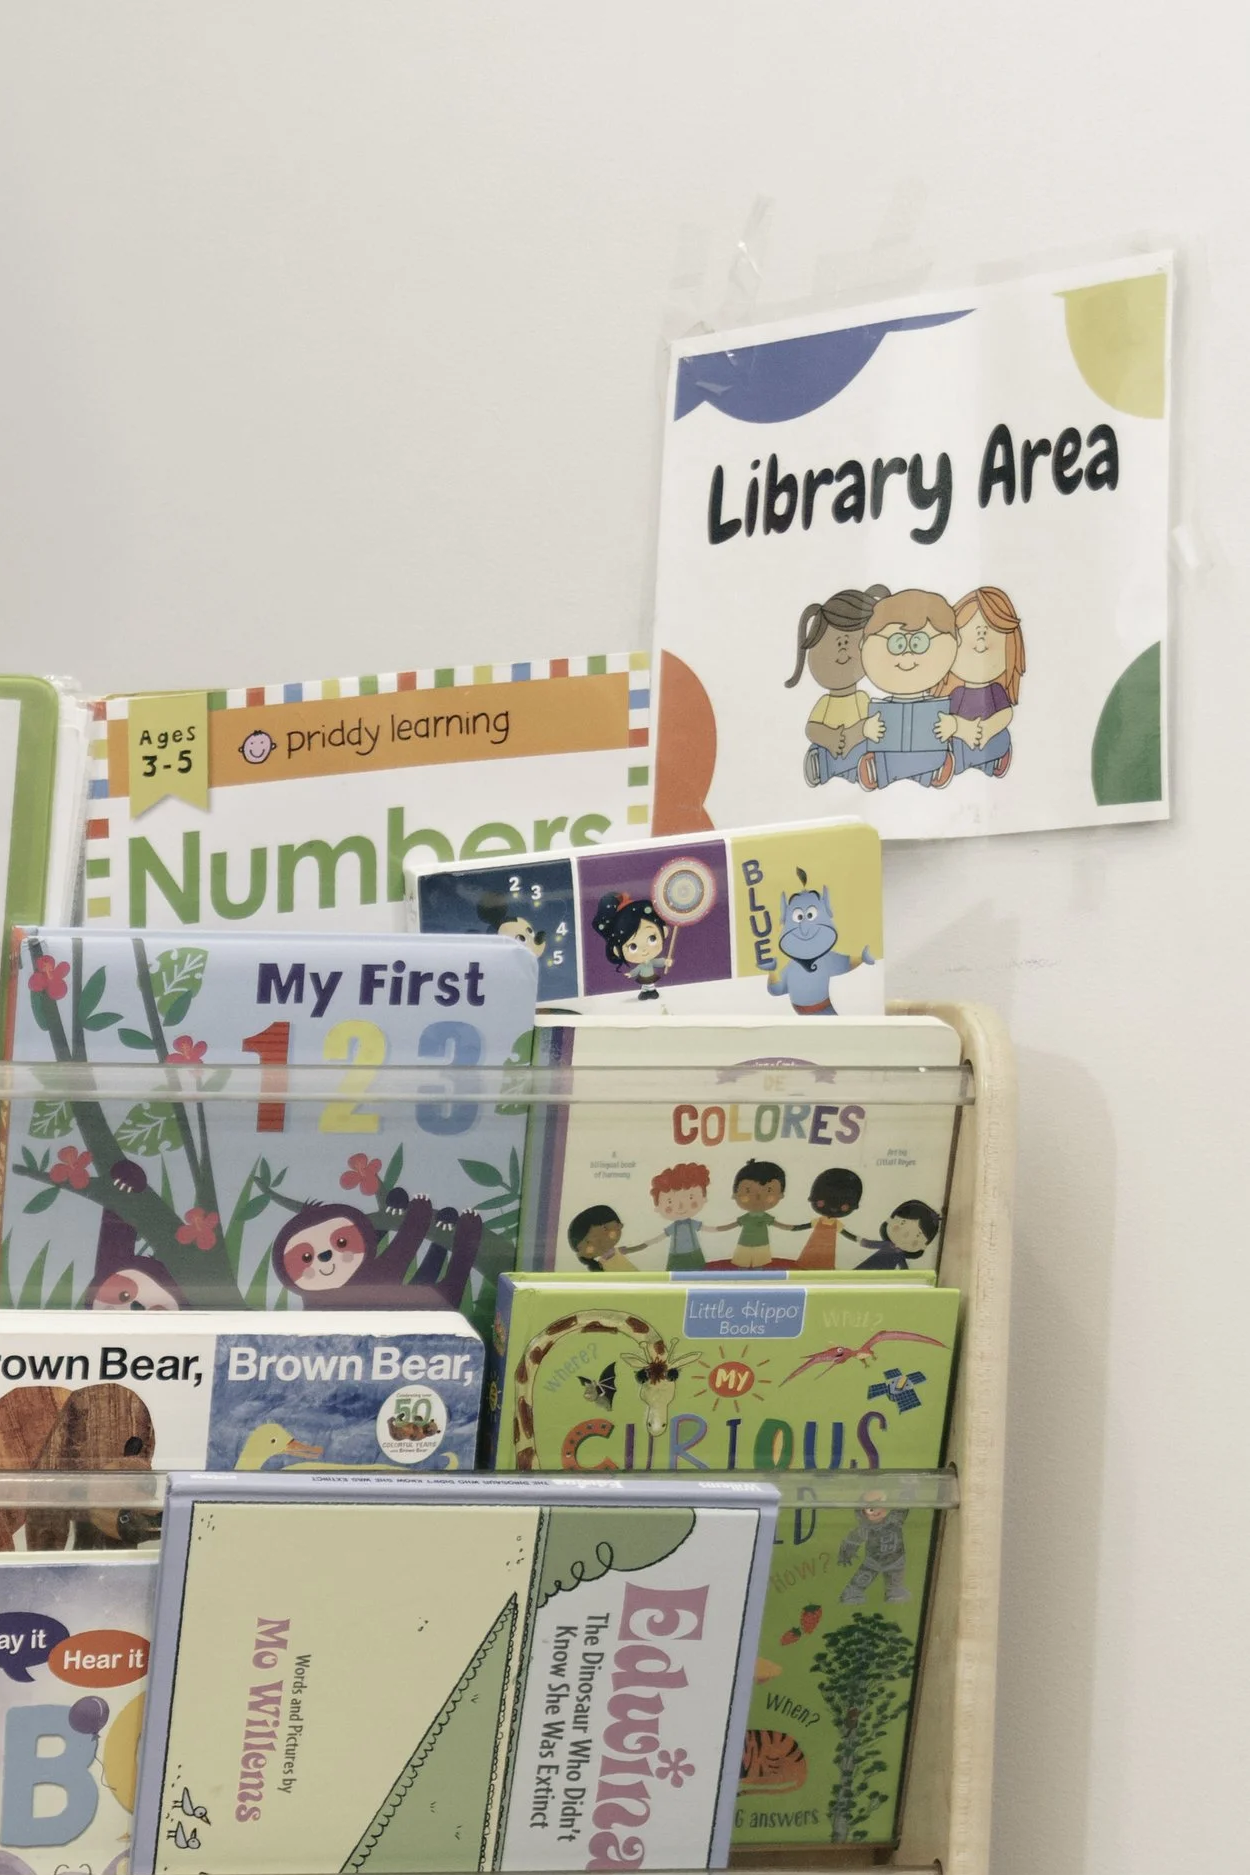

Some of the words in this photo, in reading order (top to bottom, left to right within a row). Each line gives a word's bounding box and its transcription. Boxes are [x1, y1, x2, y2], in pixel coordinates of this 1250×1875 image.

[708, 452, 954, 546] Library
[978, 424, 1120, 509] Area
[139, 725, 197, 747] Ages
[286, 721, 380, 758] priddy
[389, 710, 510, 746] learning
[141, 751, 193, 777] 3-5
[256, 962, 343, 1018] My
[358, 960, 486, 1007] First
[672, 1103, 866, 1146] COLORES
[689, 1299, 737, 1320] Little
[742, 1300, 800, 1321] Hippo
[719, 1321, 765, 1336] Books
[99, 1347, 205, 1387] Bear,
[227, 1347, 364, 1382] Brown
[371, 1347, 473, 1386] Bear,
[715, 1367, 749, 1392] MY
[395, 1398, 432, 1427] 50
[30, 1628, 46, 1650] it
[249, 1617, 290, 1669] Mo
[583, 1612, 611, 1646] The
[63, 1649, 122, 1671] Hear
[128, 1648, 144, 1669] it
[553, 1626, 578, 1678] Know
[293, 1653, 312, 1697] Words
[573, 1652, 605, 1734] Dinosaur
[289, 1698, 307, 1721] and
[545, 1683, 570, 1715] She
[765, 1692, 820, 1728] When?
[236, 1680, 284, 1824] Willems
[282, 1724, 305, 1772] Pictures
[539, 1721, 566, 1758] Was
[565, 1739, 593, 1782] Who
[277, 1773, 296, 1794] by
[529, 1764, 560, 1829] Extinct
[557, 1787, 586, 1842] Didn't
[750, 1809, 819, 1828] answers
